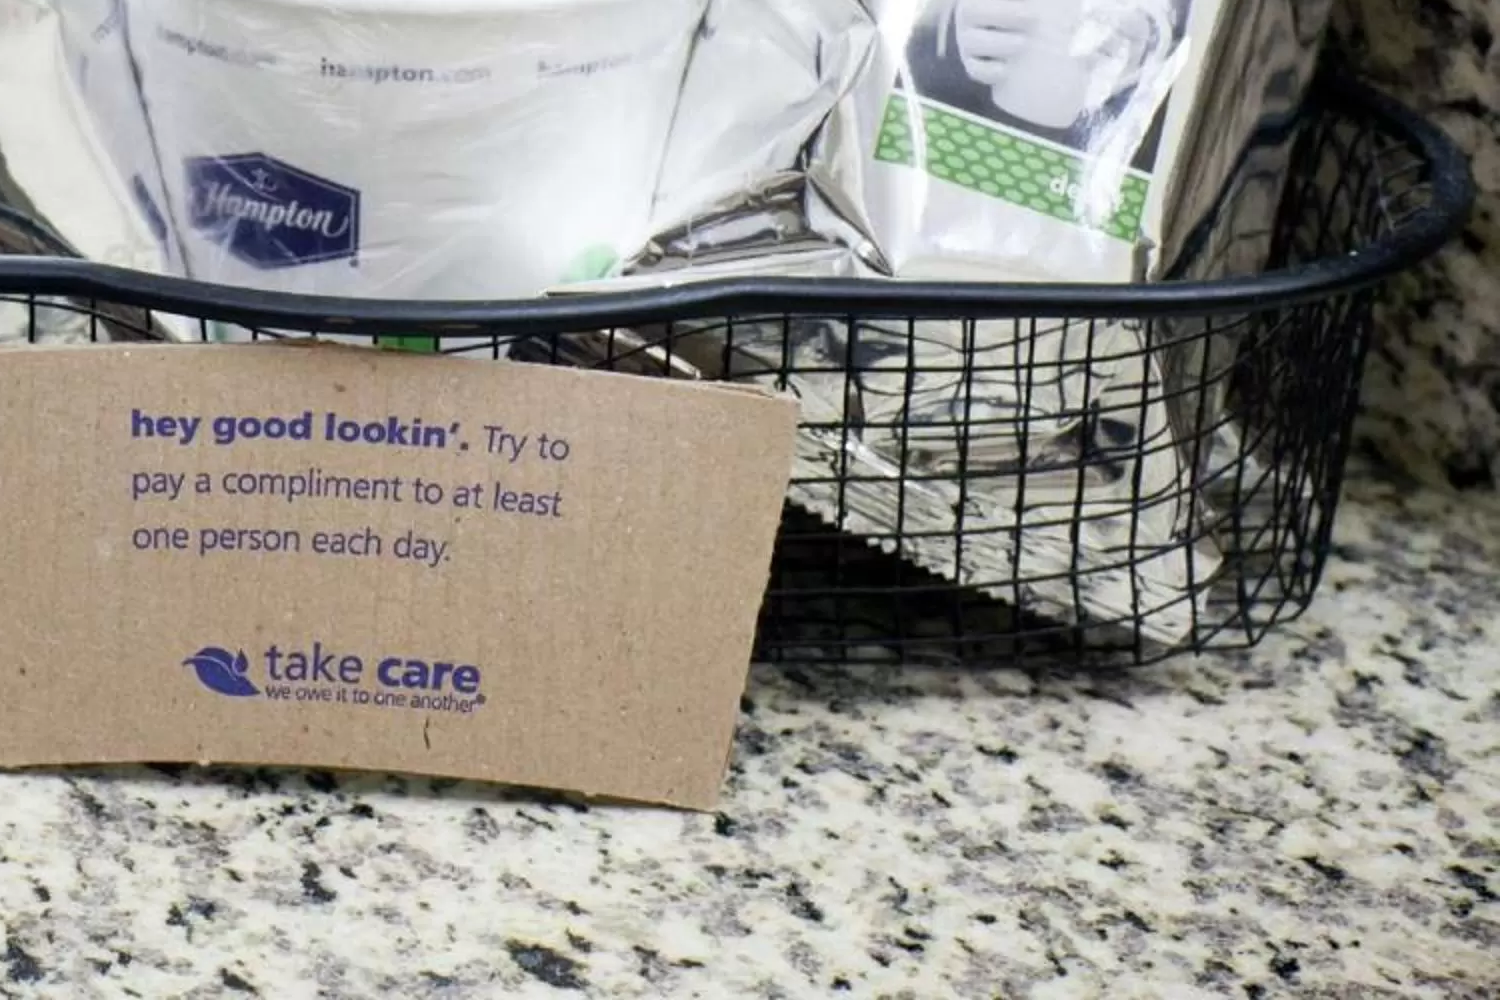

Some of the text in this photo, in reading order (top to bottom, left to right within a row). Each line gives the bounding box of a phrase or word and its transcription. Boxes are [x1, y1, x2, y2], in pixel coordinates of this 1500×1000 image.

[192, 180, 348, 238] Hampton
[131, 408, 202, 446] hey
[213, 410, 313, 445] good
[484, 425, 527, 463] Try
[538, 433, 570, 461] to
[132, 467, 563, 518] pay a compliment to at least
[132, 525, 450, 568] one person each day.
[263, 641, 481, 694] take care
[265, 684, 291, 700] we
[295, 686, 333, 702] owe
[336, 686, 348, 703] it
[353, 687, 370, 704] to
[374, 690, 406, 707] one
